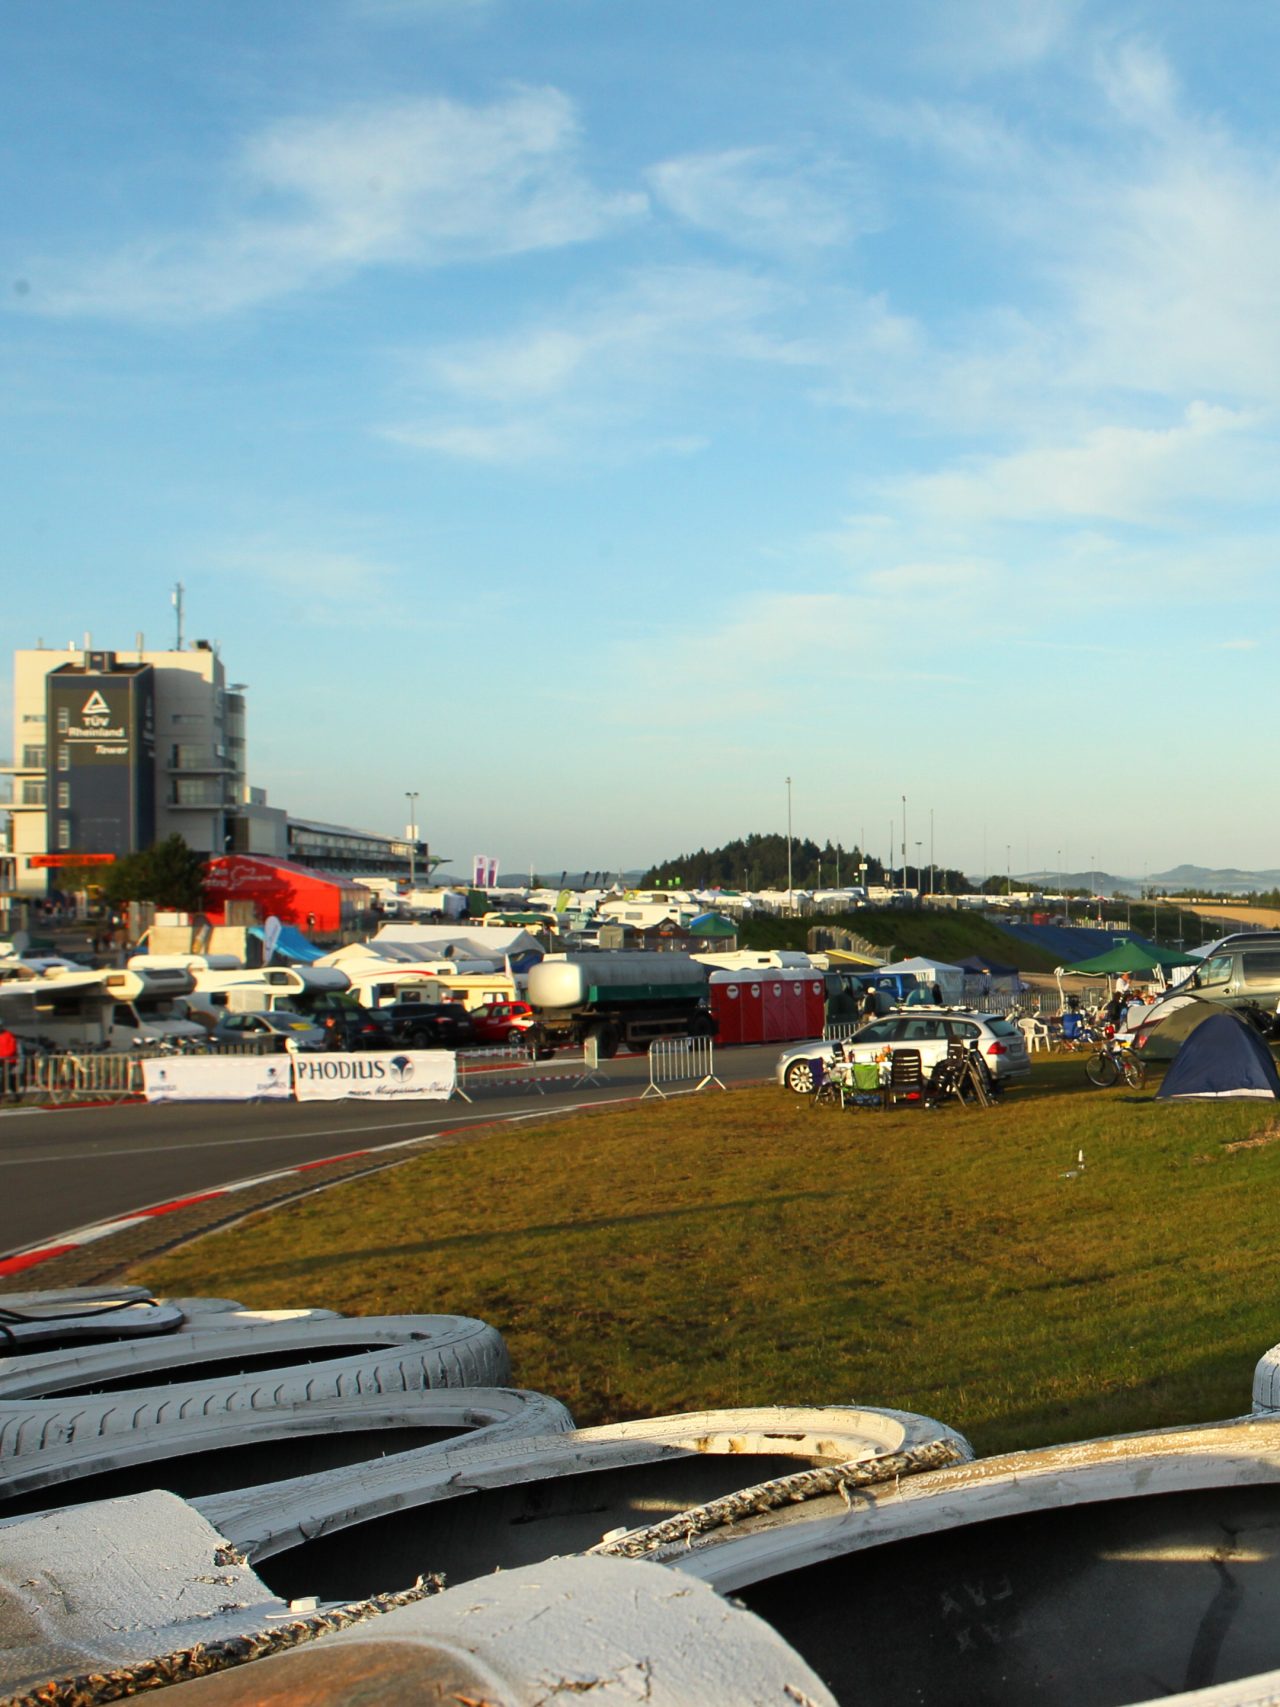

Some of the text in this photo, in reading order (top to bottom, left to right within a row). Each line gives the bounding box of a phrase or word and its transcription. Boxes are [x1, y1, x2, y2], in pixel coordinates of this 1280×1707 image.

[82, 715, 109, 727] TÜV
[67, 727, 125, 738] Rheinland
[95, 745, 128, 755] Tower
[298, 1061, 386, 1080] PHODIUS
